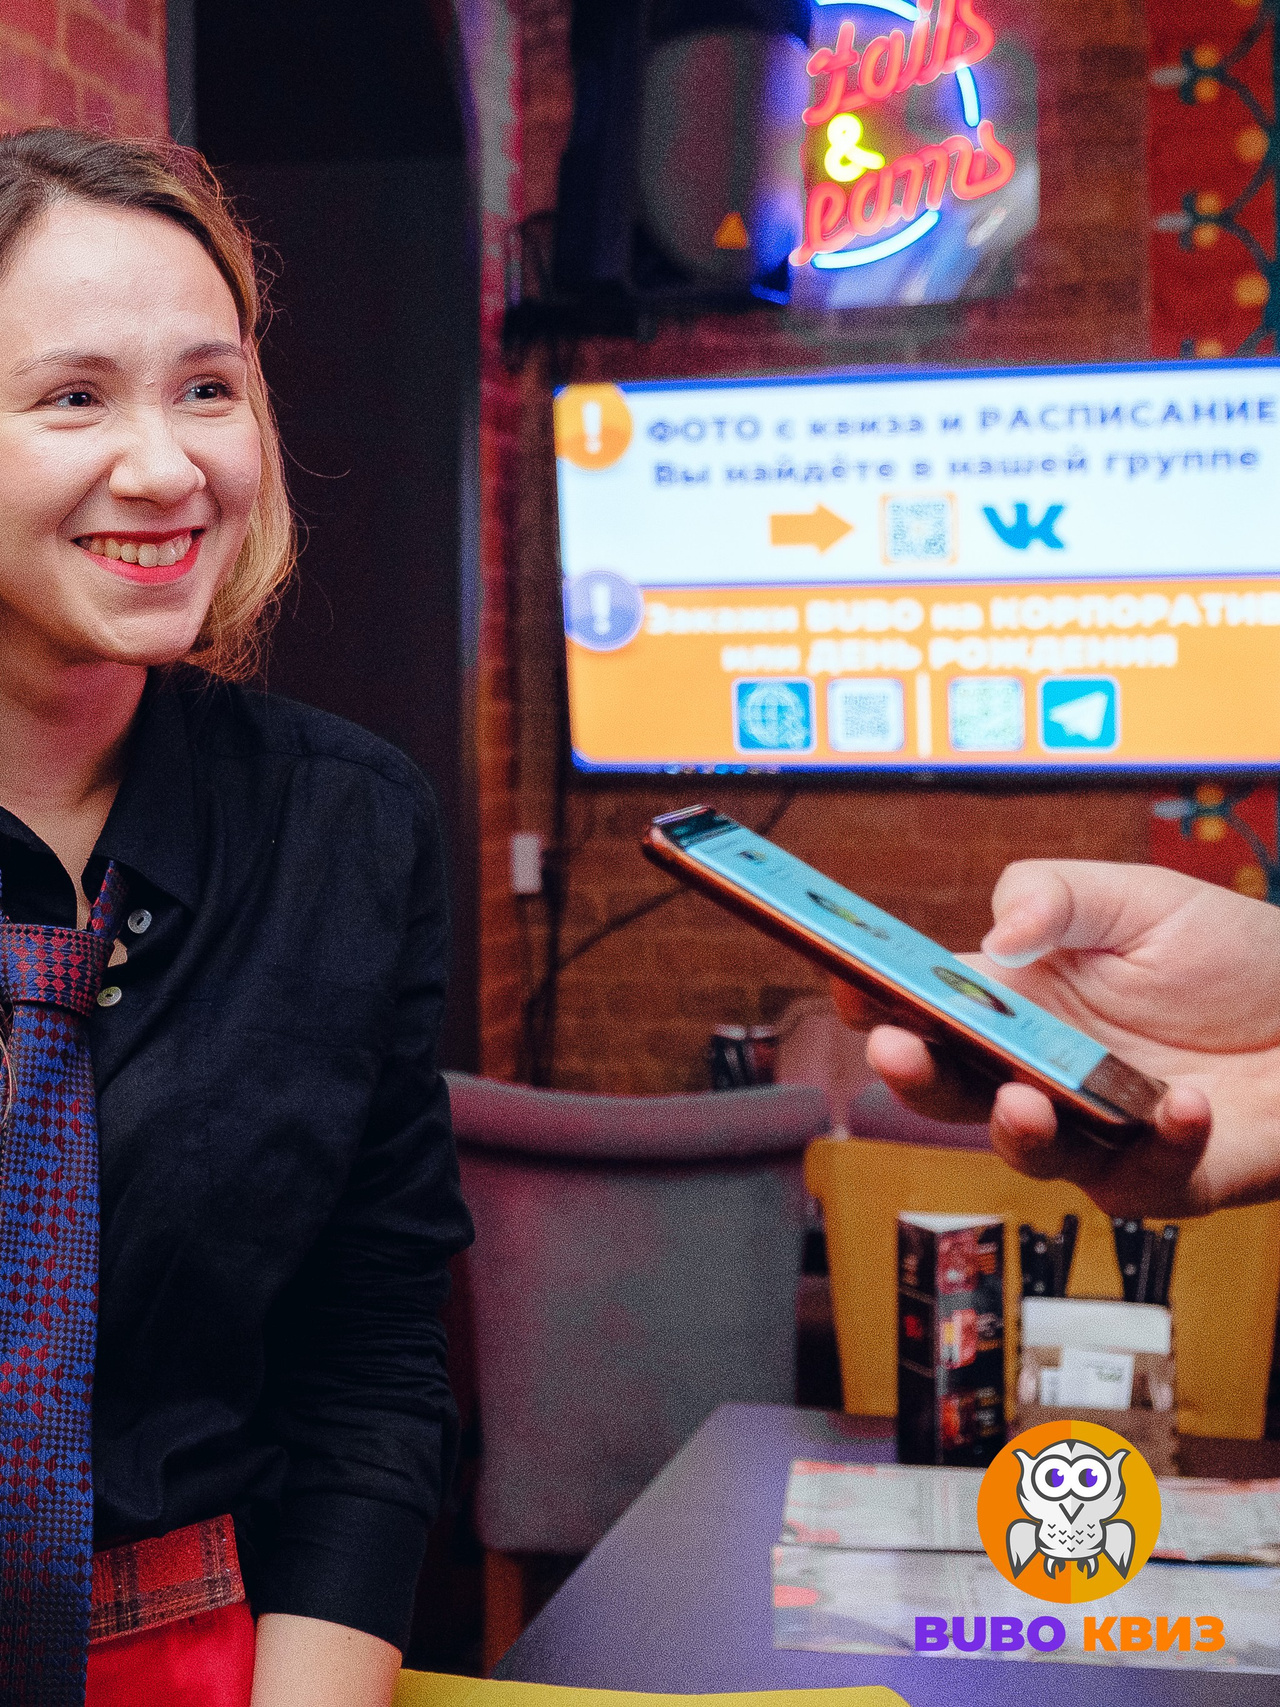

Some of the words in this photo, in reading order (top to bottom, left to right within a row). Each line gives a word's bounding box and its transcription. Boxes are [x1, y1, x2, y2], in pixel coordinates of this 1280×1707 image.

[825, 112, 885, 182] &
[647, 415, 760, 442] ФОТО
[941, 413, 961, 434] и
[979, 396, 1277, 431] РАСПИСАНИЕ
[654, 462, 709, 485] Вы
[726, 451, 895, 486] найдёте
[914, 461, 930, 478] в
[949, 443, 1088, 476] нашей
[1106, 449, 1258, 482] группе
[807, 599, 923, 632] BUBO
